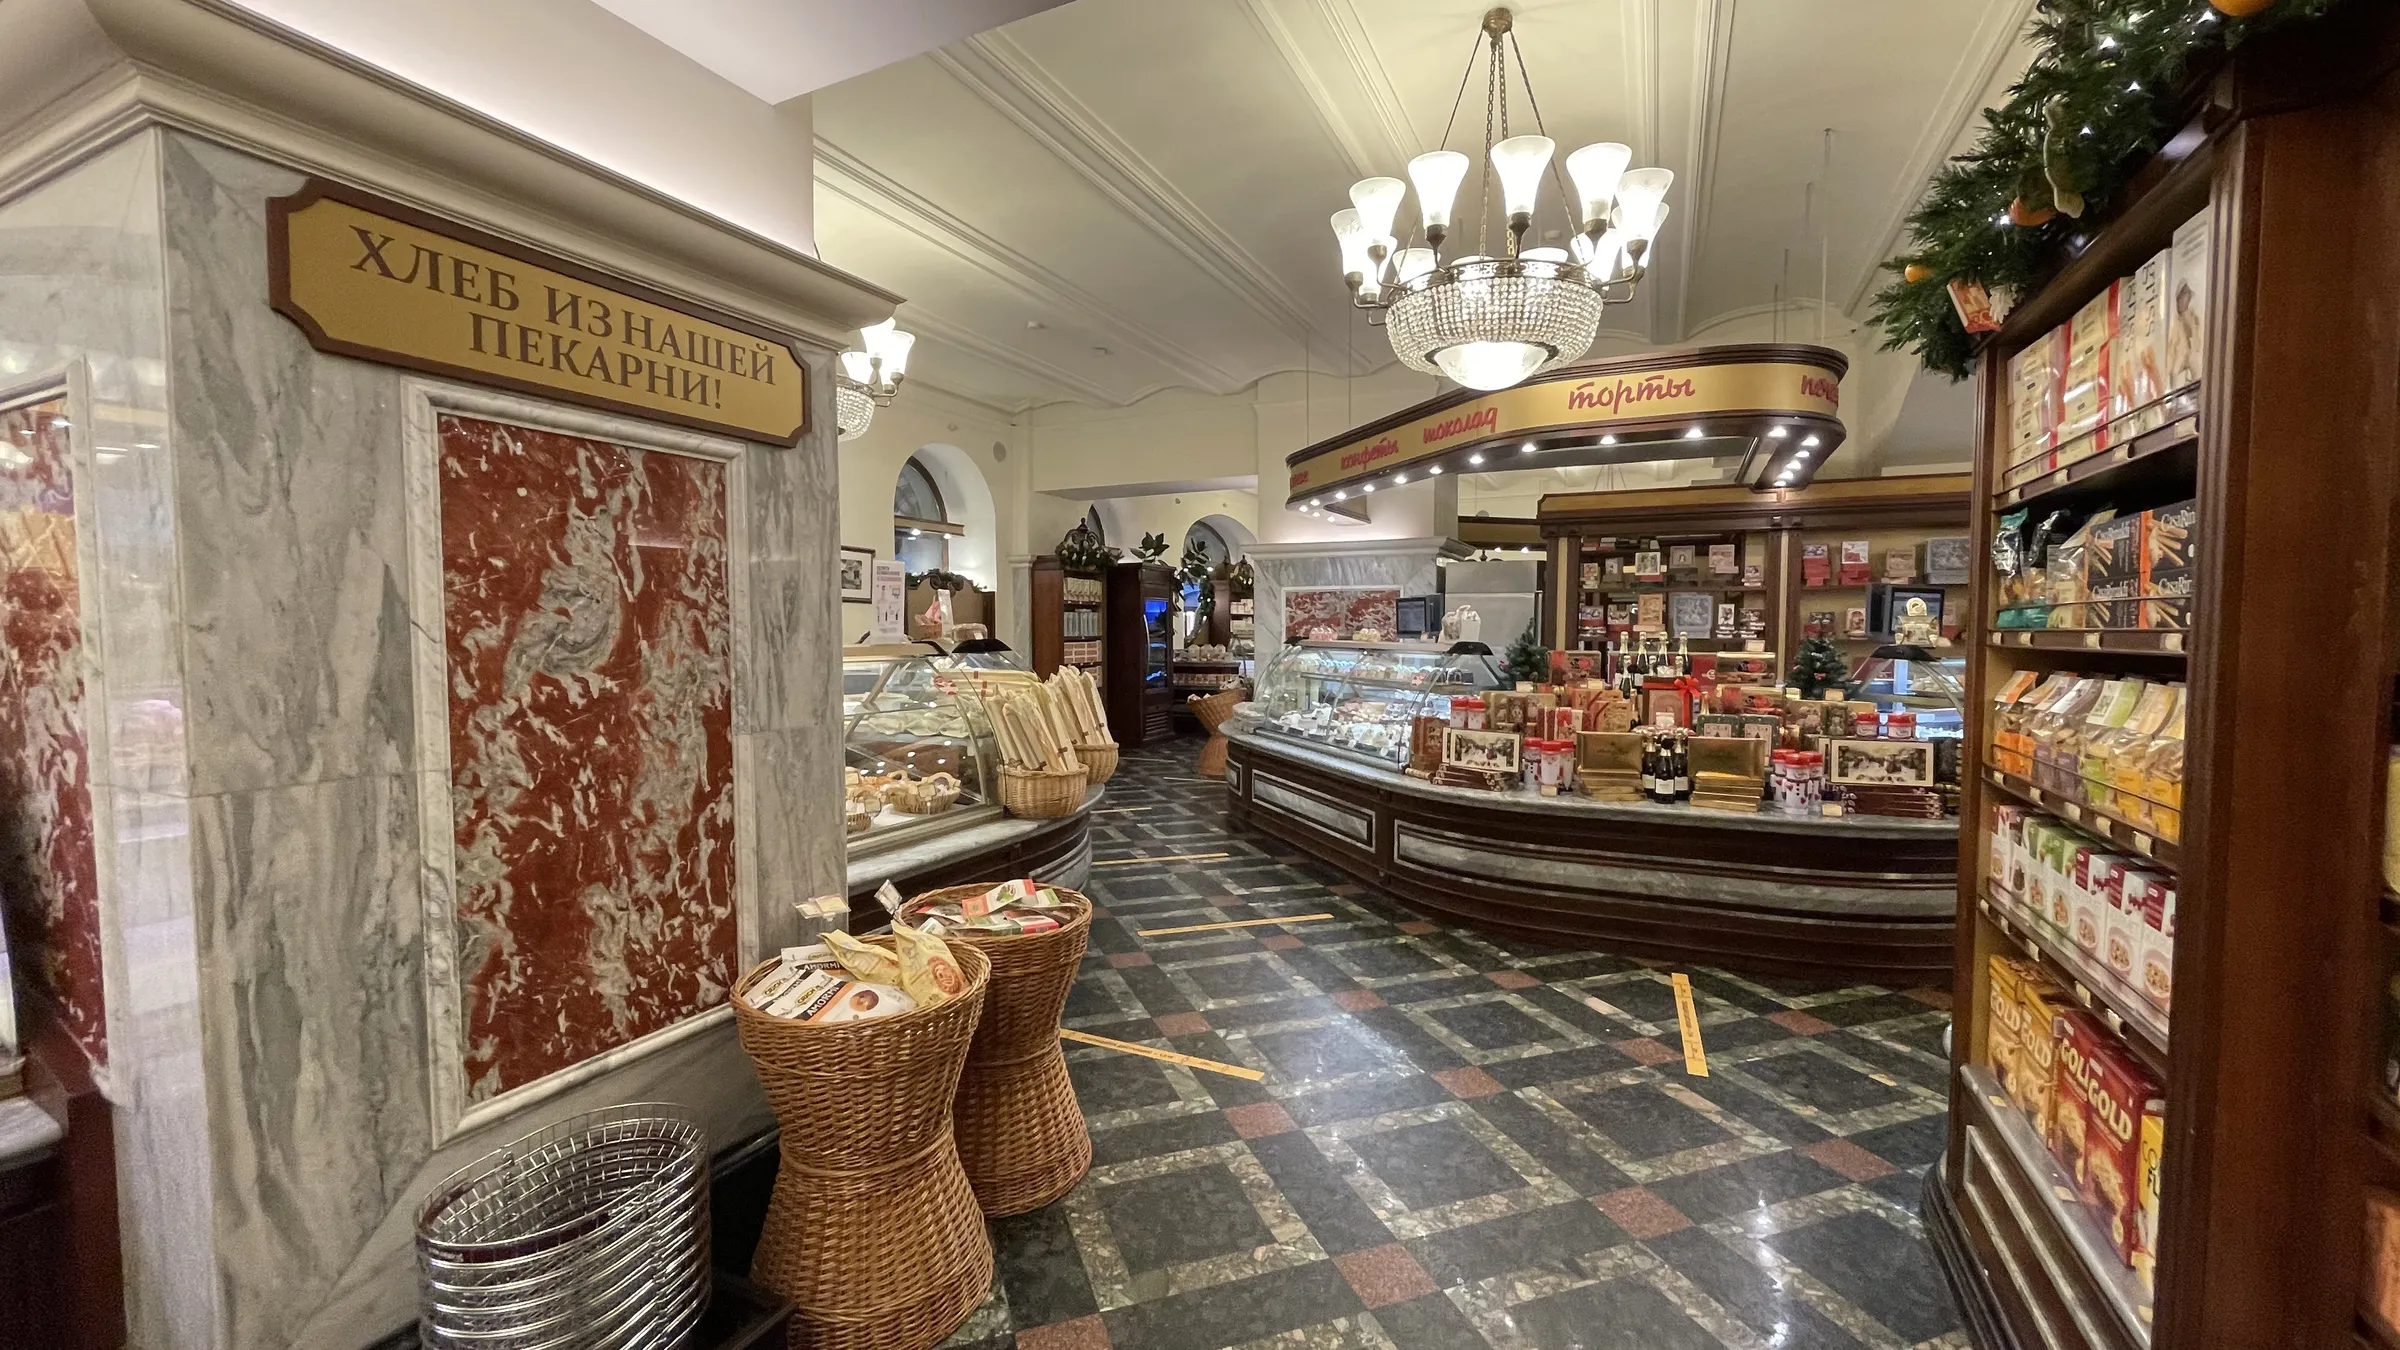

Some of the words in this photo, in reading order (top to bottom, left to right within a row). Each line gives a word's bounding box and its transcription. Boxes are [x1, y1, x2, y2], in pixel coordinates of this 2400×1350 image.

[349, 224, 521, 312] ХЛЕБ
[543, 285, 613, 338] ИЗ
[622, 310, 775, 386] НАШЕЙ
[468, 311, 722, 410] ПЕКАРНИ!
[1422, 407, 1498, 445] шоколад
[1568, 375, 1696, 415] торты
[1989, 992, 2021, 1032] GOLD
[2021, 1022, 2052, 1068] GOLD
[2060, 1037, 2090, 1086] GOL
[2088, 1078, 2133, 1141] GOLD
